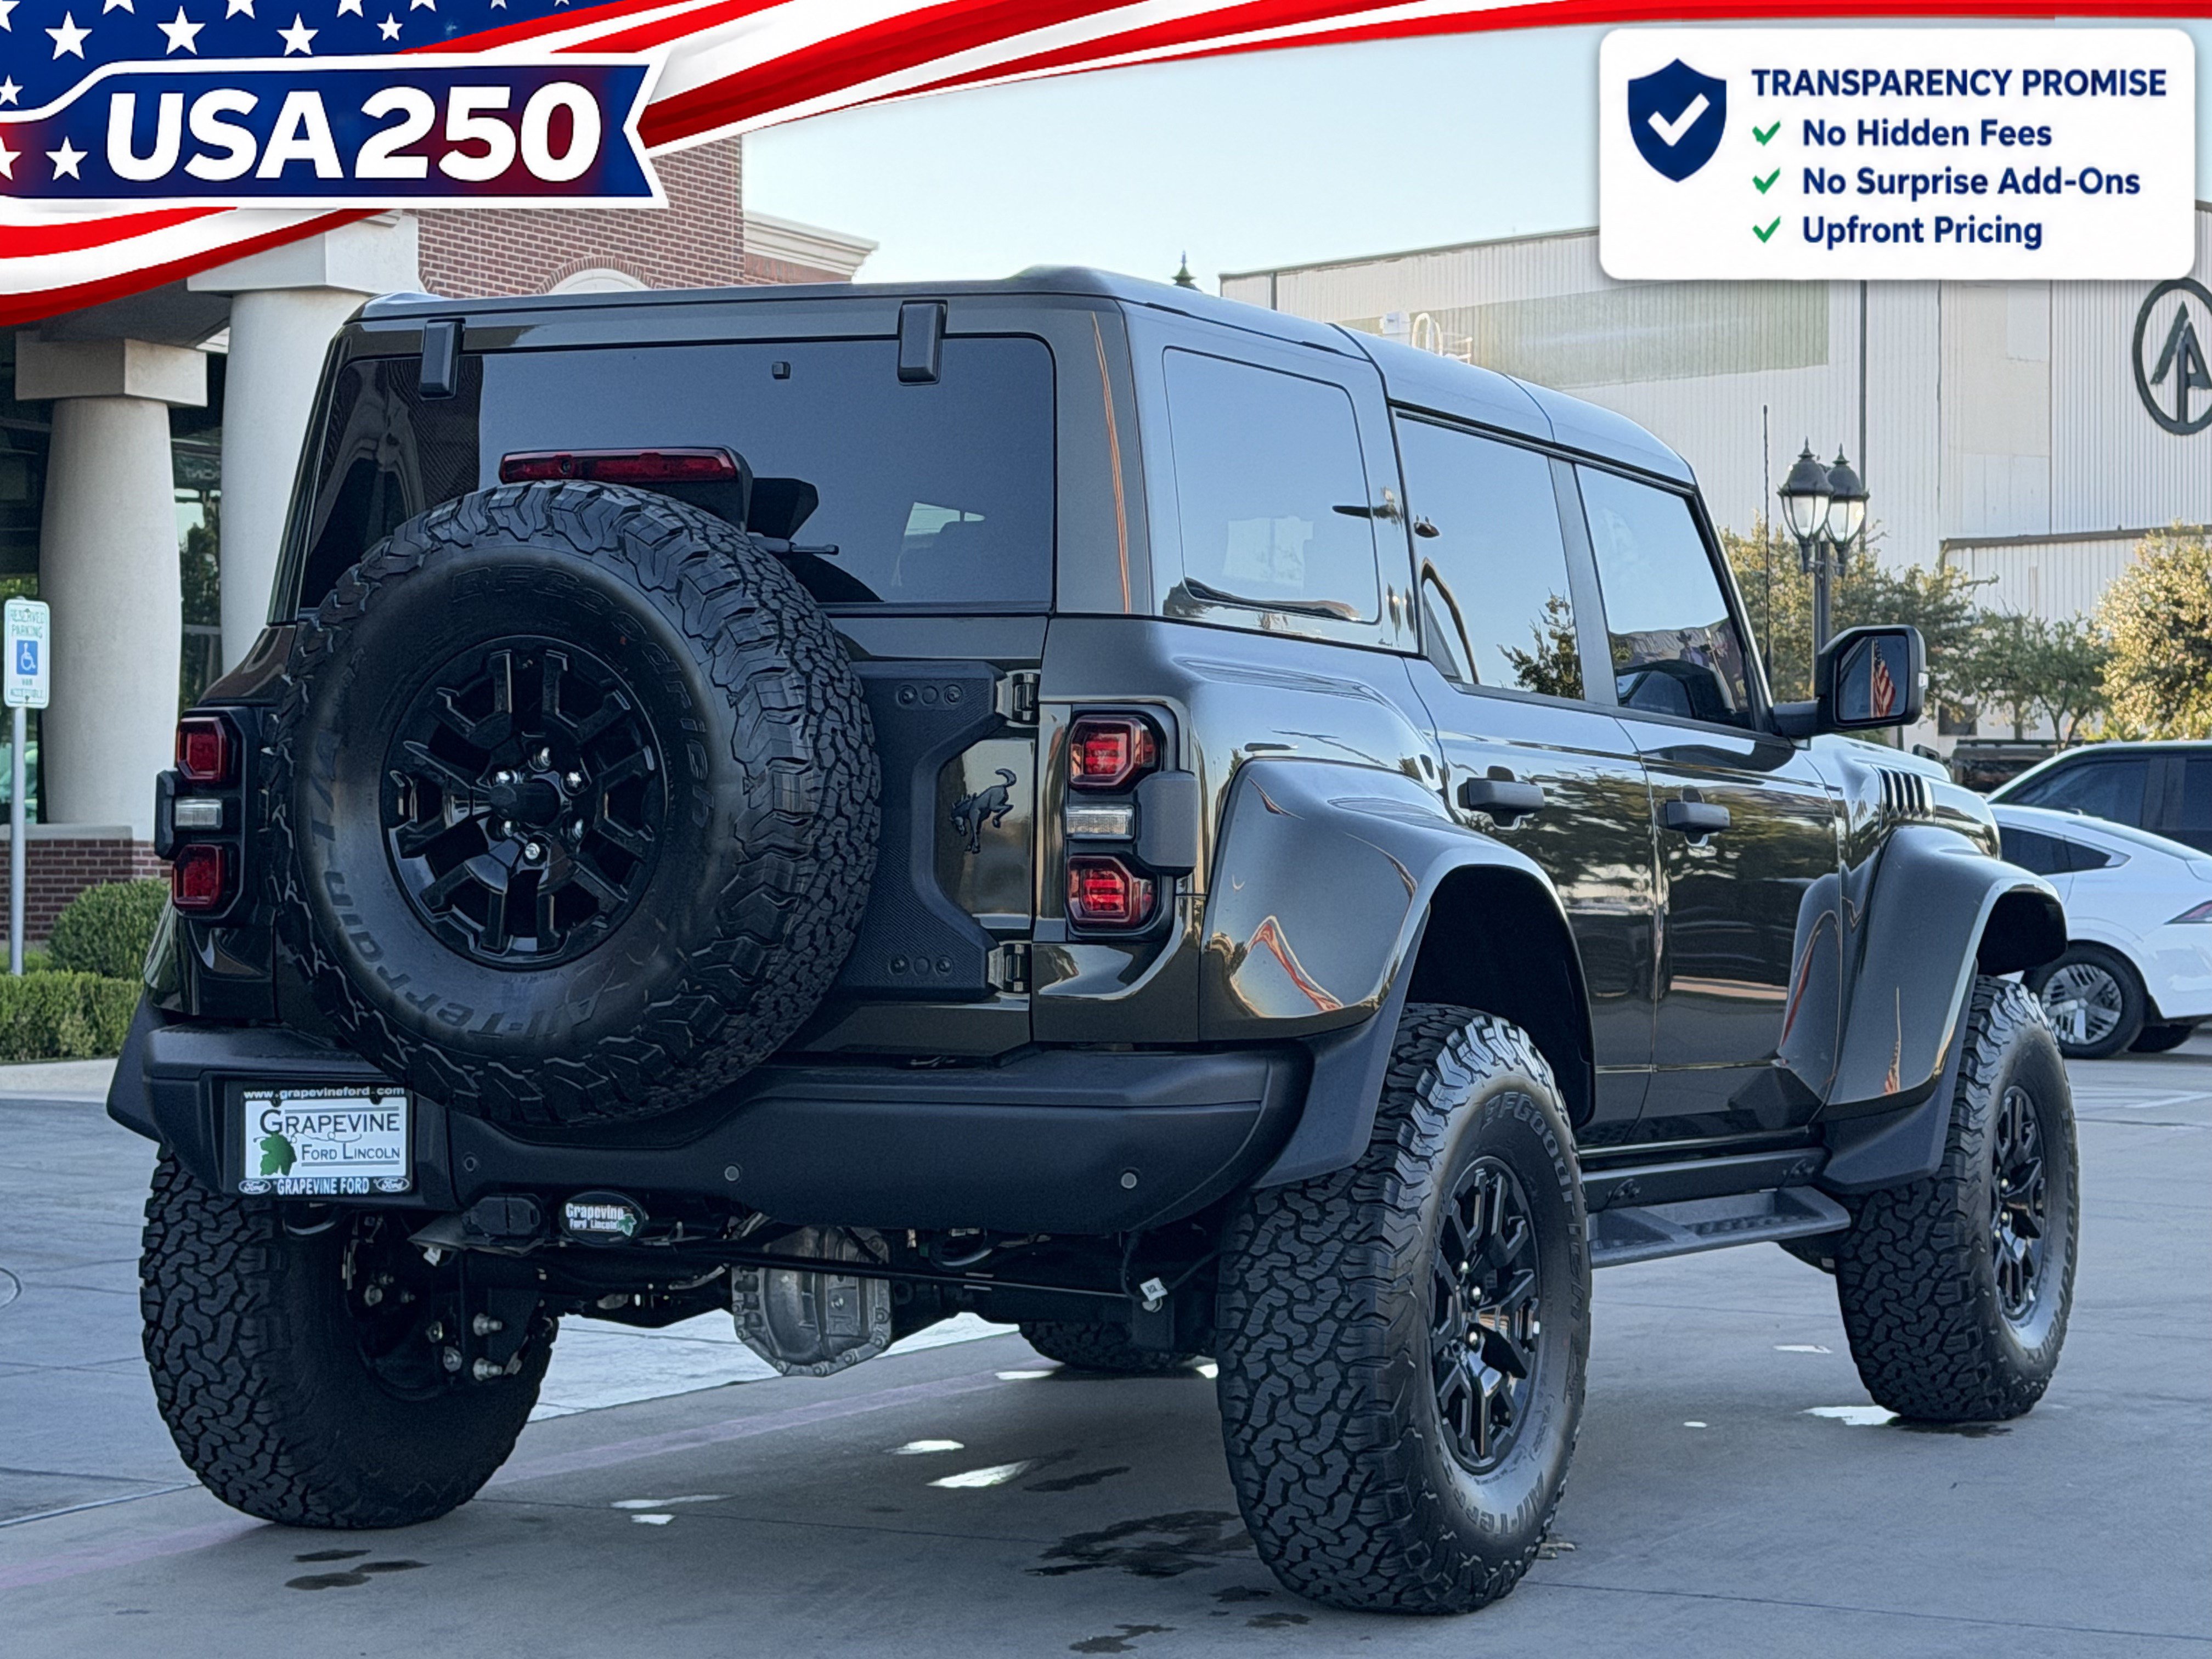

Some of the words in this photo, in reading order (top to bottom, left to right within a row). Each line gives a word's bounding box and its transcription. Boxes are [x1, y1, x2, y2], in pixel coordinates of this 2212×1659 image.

[244, 1086, 404, 1099] www.grapevineford.com
[259, 1109, 400, 1135] GRAPEVINE
[277, 1178, 337, 1195] GRAPEVINE
[340, 1177, 370, 1194] FORD
[565, 1203, 624, 1220] Grapevine
